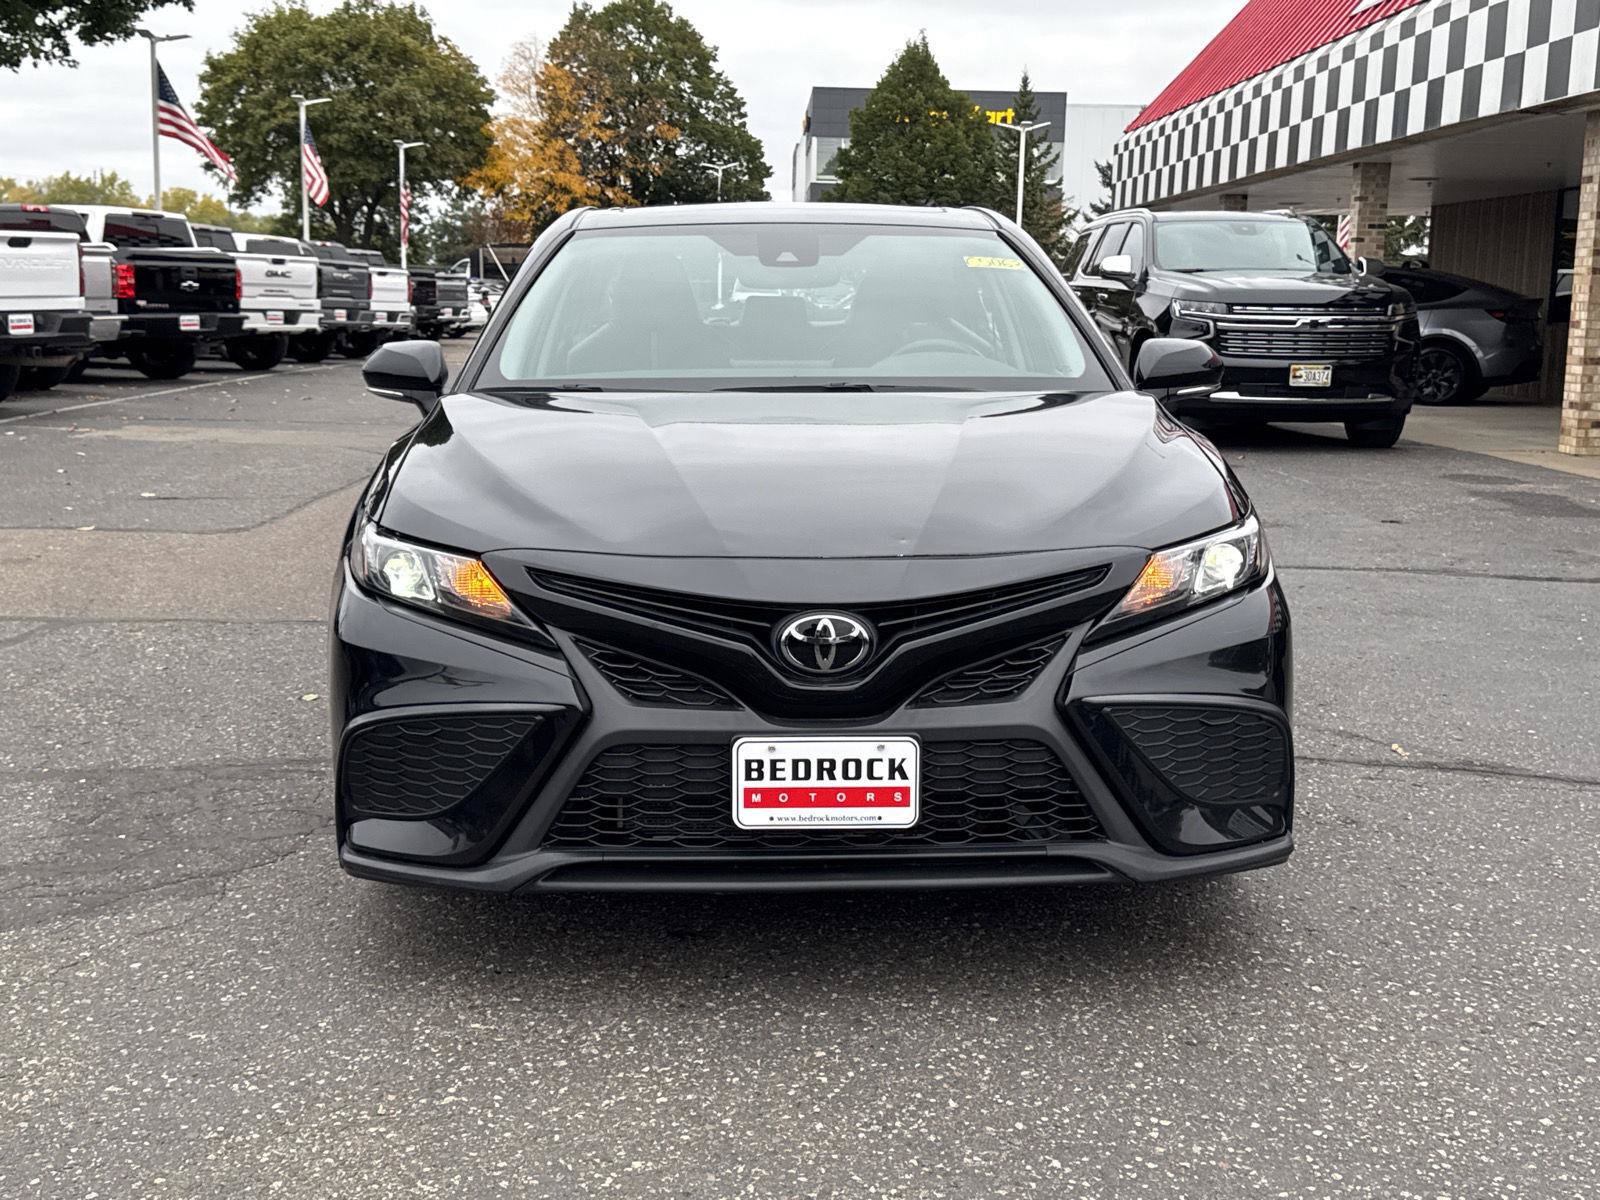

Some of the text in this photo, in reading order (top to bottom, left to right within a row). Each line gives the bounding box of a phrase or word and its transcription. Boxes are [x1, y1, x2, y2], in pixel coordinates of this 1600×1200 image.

[265, 270, 292, 278] GMC
[744, 758, 909, 781] BEDROCK
[751, 791, 903, 803] MOTORS
[776, 814, 877, 823] www.bedrockmotors.com
